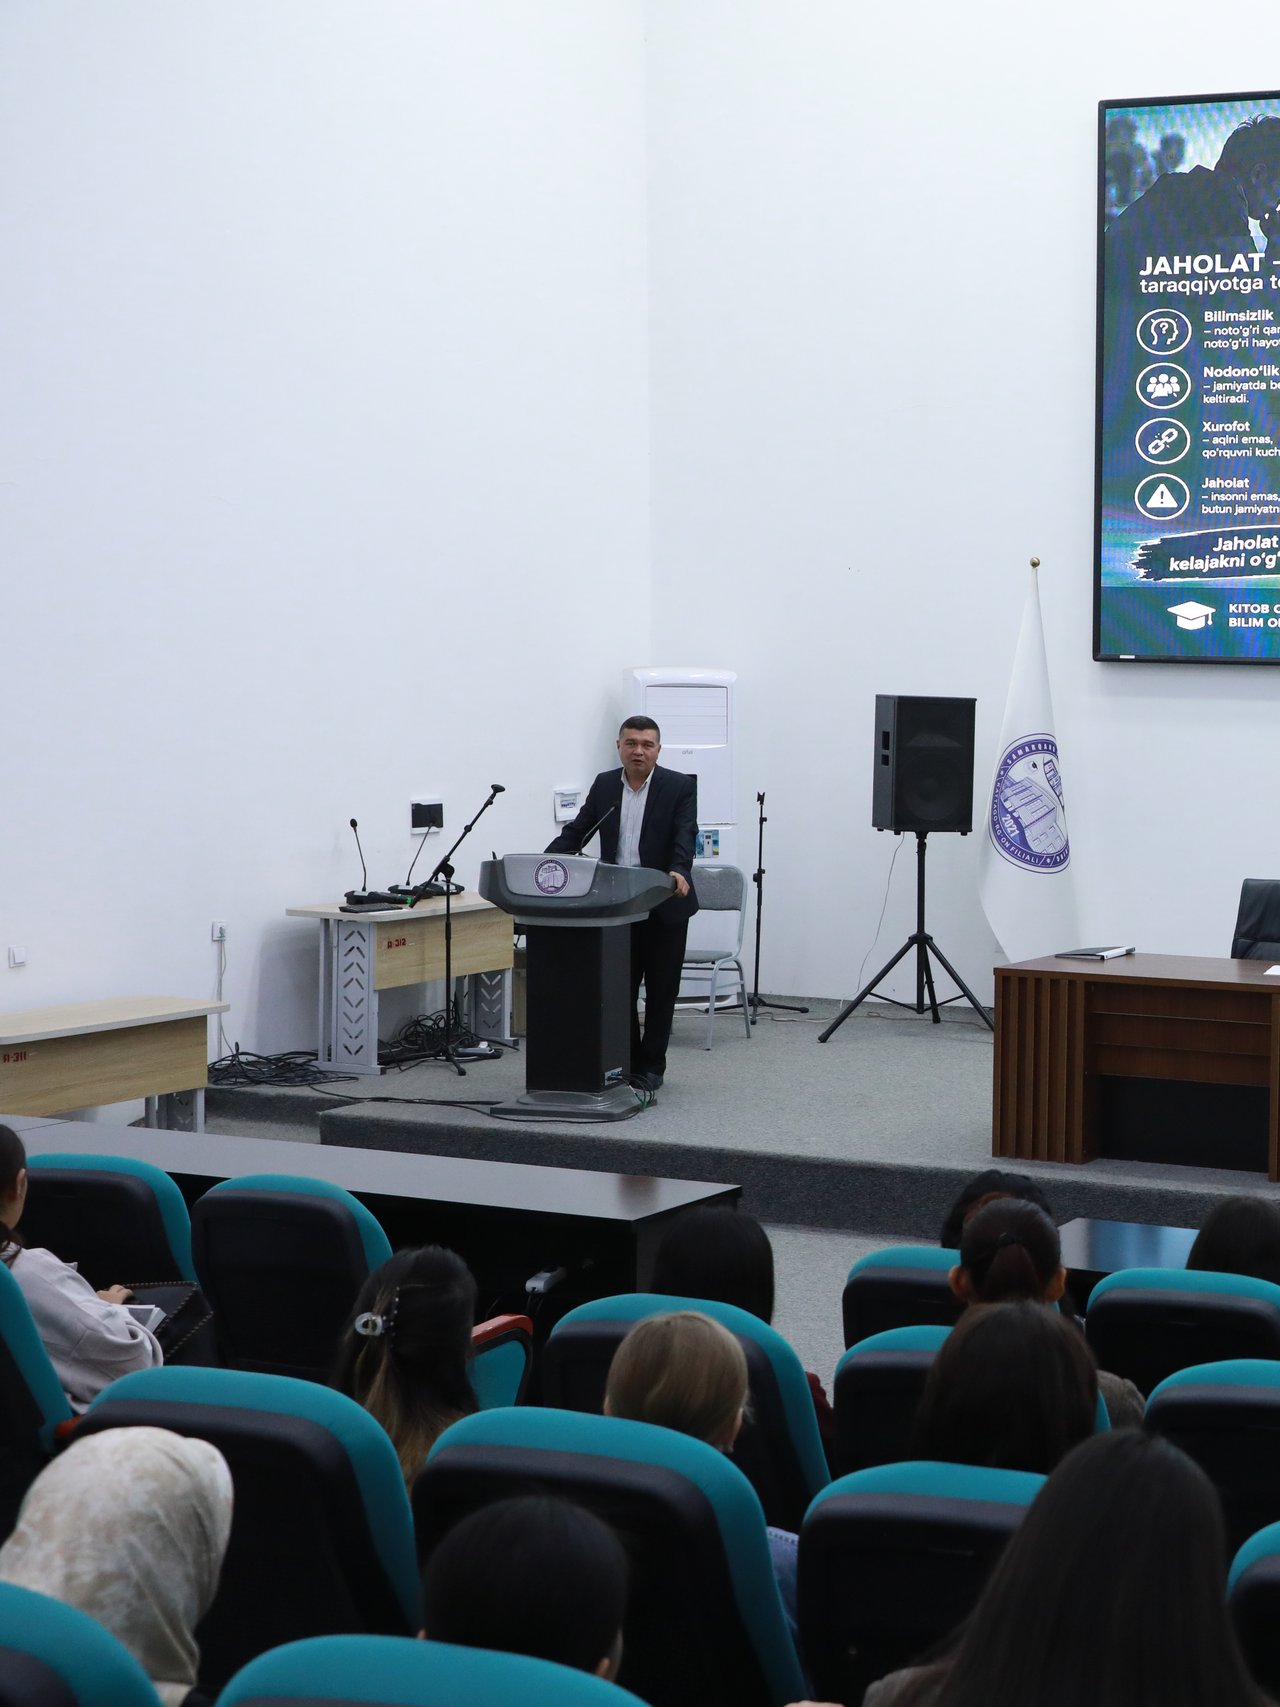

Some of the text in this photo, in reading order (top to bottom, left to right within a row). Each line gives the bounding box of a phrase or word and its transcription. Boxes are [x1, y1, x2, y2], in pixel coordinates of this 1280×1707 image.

[1139, 253, 1265, 276] JAHOLAT
[1140, 276, 1264, 296] taraqqiyotga
[1204, 310, 1274, 322] Bilimsizlik
[1212, 380, 1267, 392] jamiyatda
[1203, 393, 1249, 404] keltiradi.
[1202, 421, 1250, 432] Xurofot
[1212, 435, 1239, 447] aqlni
[1242, 437, 1274, 446] emas,
[1202, 478, 1249, 489] Jaholat
[1211, 491, 1248, 501] insonni
[1250, 493, 1280, 502] emas,
[1201, 504, 1232, 514] butun
[1213, 535, 1279, 552] Jaholat
[1170, 552, 1245, 572] kelajakni
[1228, 603, 1273, 615] KITOB
[1228, 617, 1266, 628] BILIM
[1001, 813, 1020, 838] 2021
[1010, 847, 1039, 864] FILIALI
